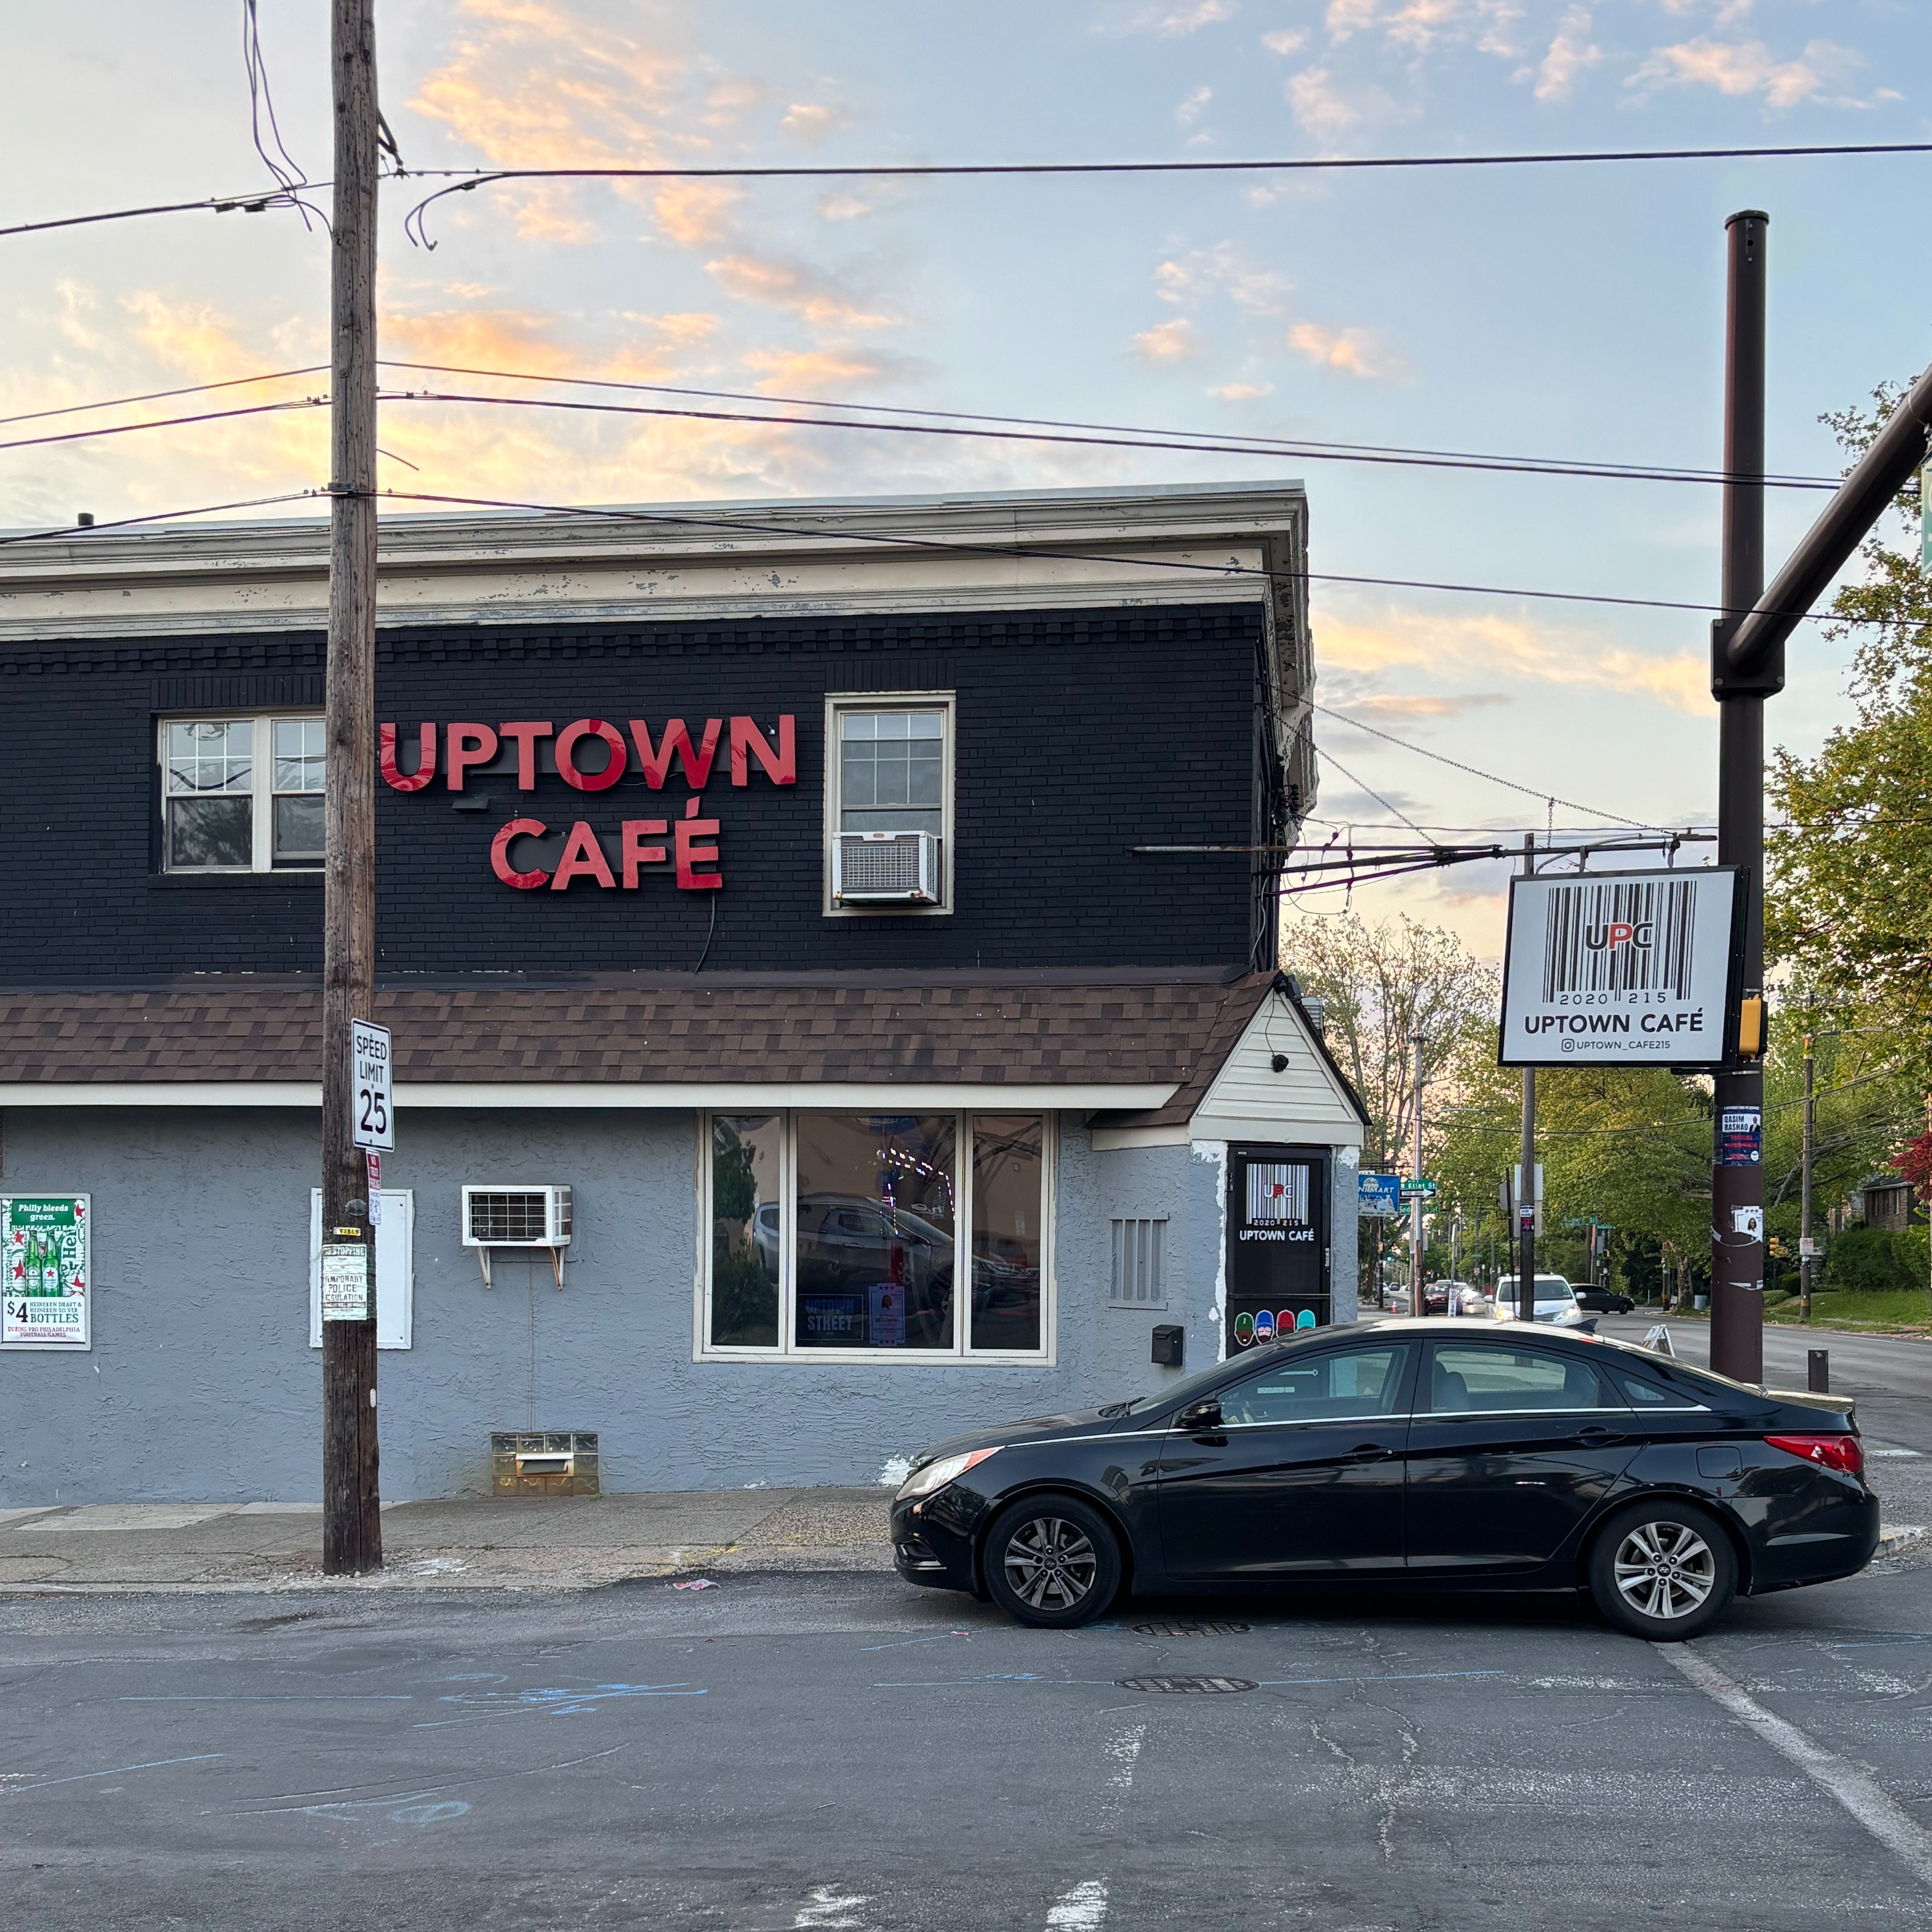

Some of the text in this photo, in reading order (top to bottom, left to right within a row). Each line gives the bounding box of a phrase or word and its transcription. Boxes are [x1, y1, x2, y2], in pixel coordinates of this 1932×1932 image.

[380, 714, 796, 792] UPTOWN
[490, 796, 722, 890] CAFÉ
[1586, 923, 1653, 950] UPC
[1559, 992, 1666, 1005] 2020 215
[1525, 1007, 1703, 1034] UPTOWN CAFÉ
[357, 1035, 387, 1060] SPEED
[1577, 1040, 1670, 1051] UPTOWN_CAFE215
[360, 1060, 384, 1083] LIMIT
[360, 1089, 386, 1135] 25
[1264, 1184, 1293, 1198] UPC
[18, 1204, 42, 1213] Philly
[1240, 1228, 1314, 1241] UPTOWN CAFÉ
[328, 1284, 357, 1293] POLICE
[7, 1301, 28, 1323] $4
[31, 1314, 79, 1323] BOTTLES
[807, 1316, 853, 1331] STREET
